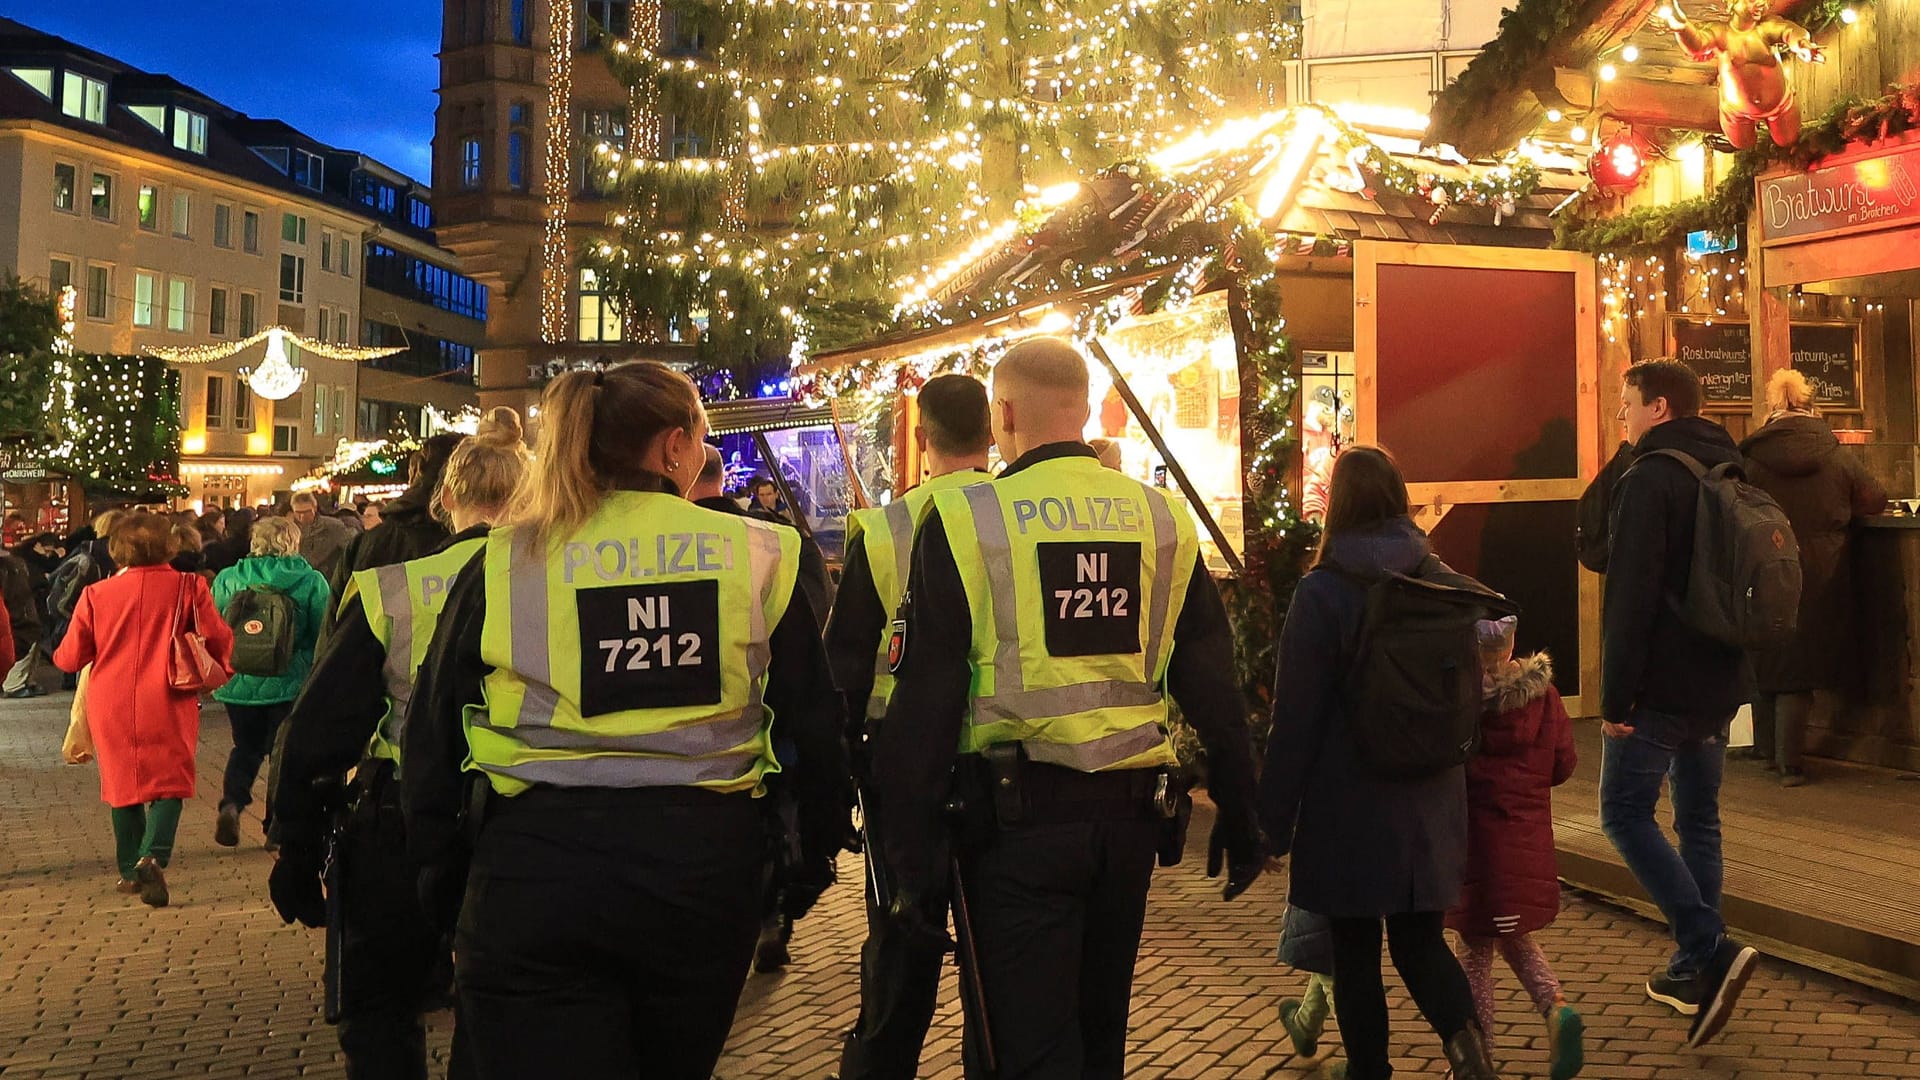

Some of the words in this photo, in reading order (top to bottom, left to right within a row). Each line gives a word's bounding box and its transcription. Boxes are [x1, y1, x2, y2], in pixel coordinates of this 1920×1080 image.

[1767, 178, 1876, 229] Bratwurst
[1013, 496, 1145, 534] POLIZEI
[563, 532, 733, 583] POLIZEI
[1076, 552, 1108, 583] NI
[627, 595, 670, 631] NI
[1054, 587, 1129, 619] 7212
[599, 632, 702, 672] 7212
